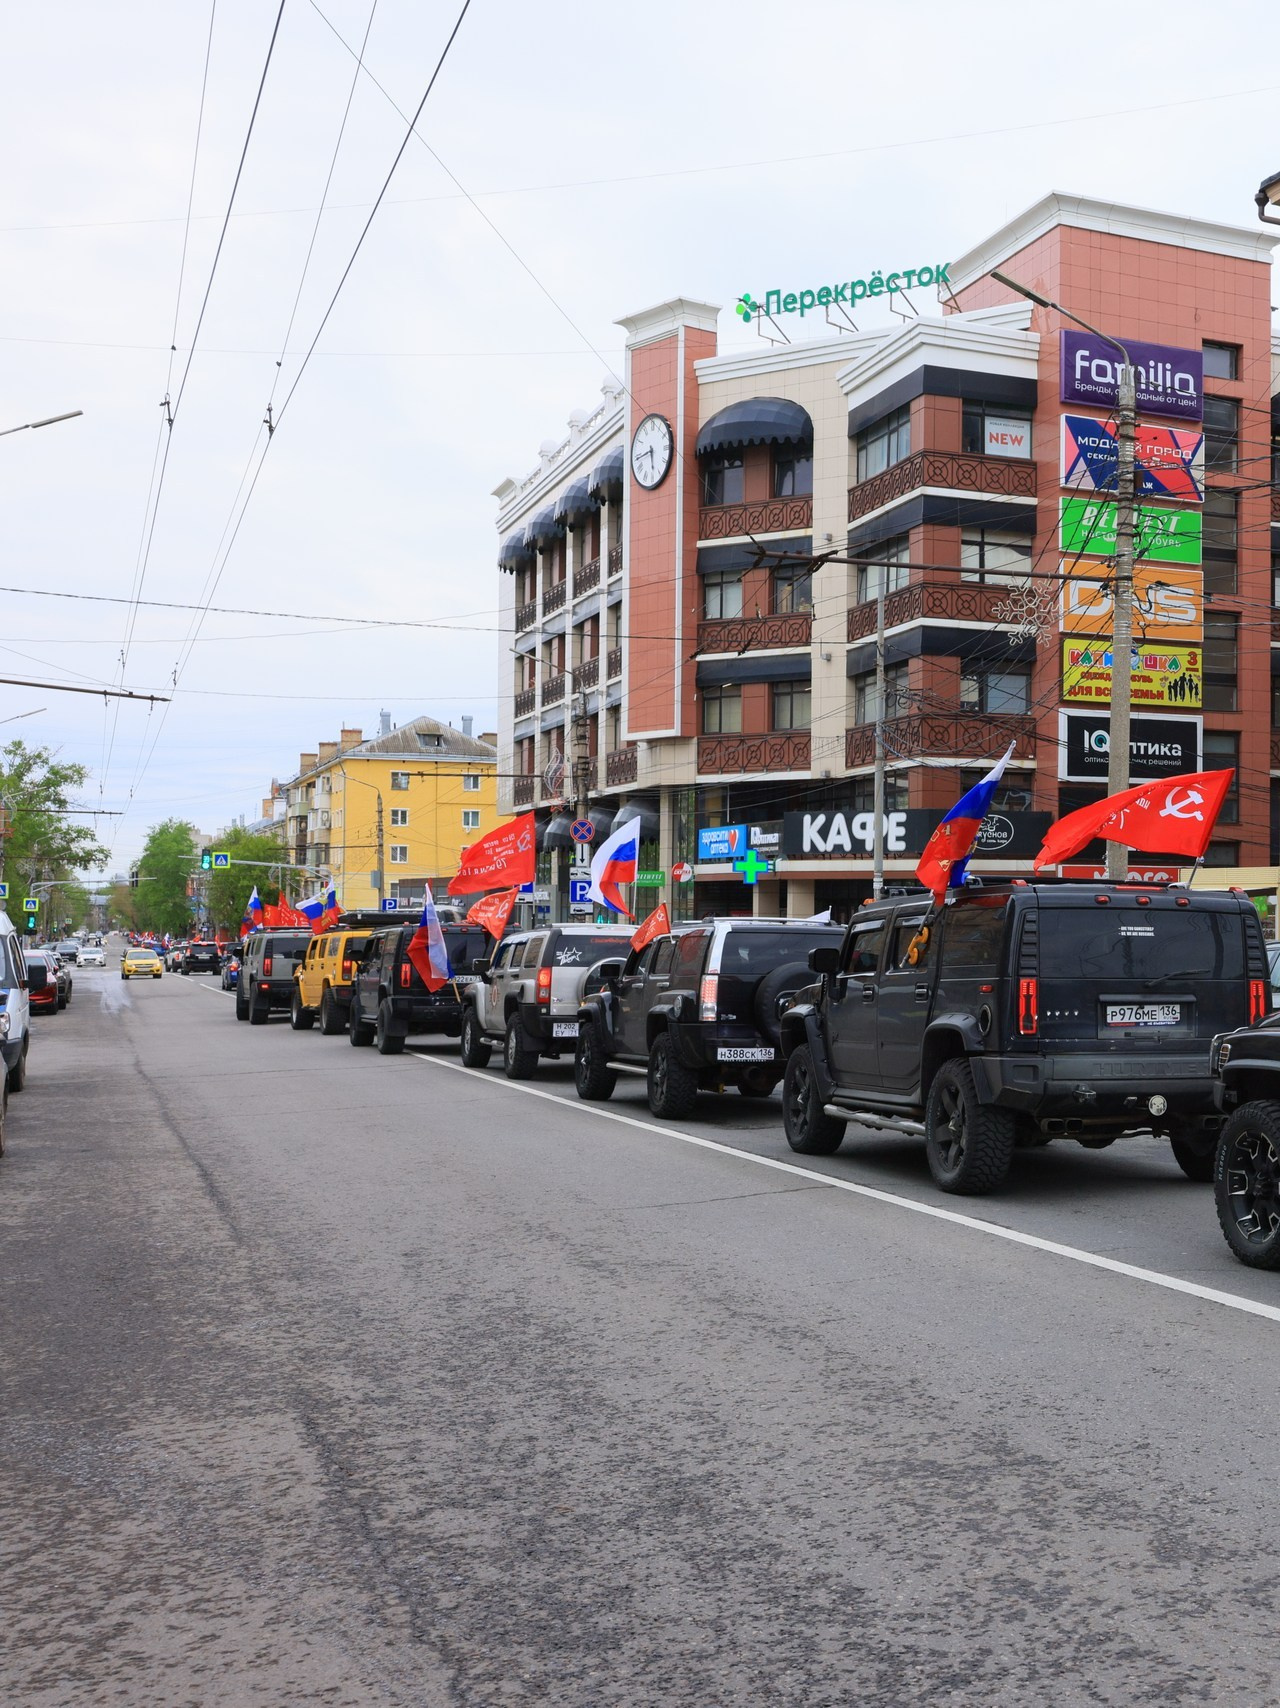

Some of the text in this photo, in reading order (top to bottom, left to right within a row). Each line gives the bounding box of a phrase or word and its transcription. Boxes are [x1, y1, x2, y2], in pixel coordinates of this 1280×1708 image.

[764, 261, 952, 318] Перекрёсток
[1074, 380, 1114, 396] Бренды,
[1166, 397, 1176, 405] от
[1178, 398, 1197, 408] цен!
[989, 431, 1024, 447] NEW
[1146, 446, 1193, 459] ГОРОД
[1187, 651, 1198, 666] 3
[1068, 686, 1093, 697] ДЛЯ
[1148, 759, 1182, 767] решений
[802, 811, 908, 853] КАФЕ
[710, 842, 729, 855] аптека
[386, 900, 395, 911] P
[1110, 1006, 1177, 1021] Р976МЕ 136
[720, 1048, 772, 1059] Н388СК 136
